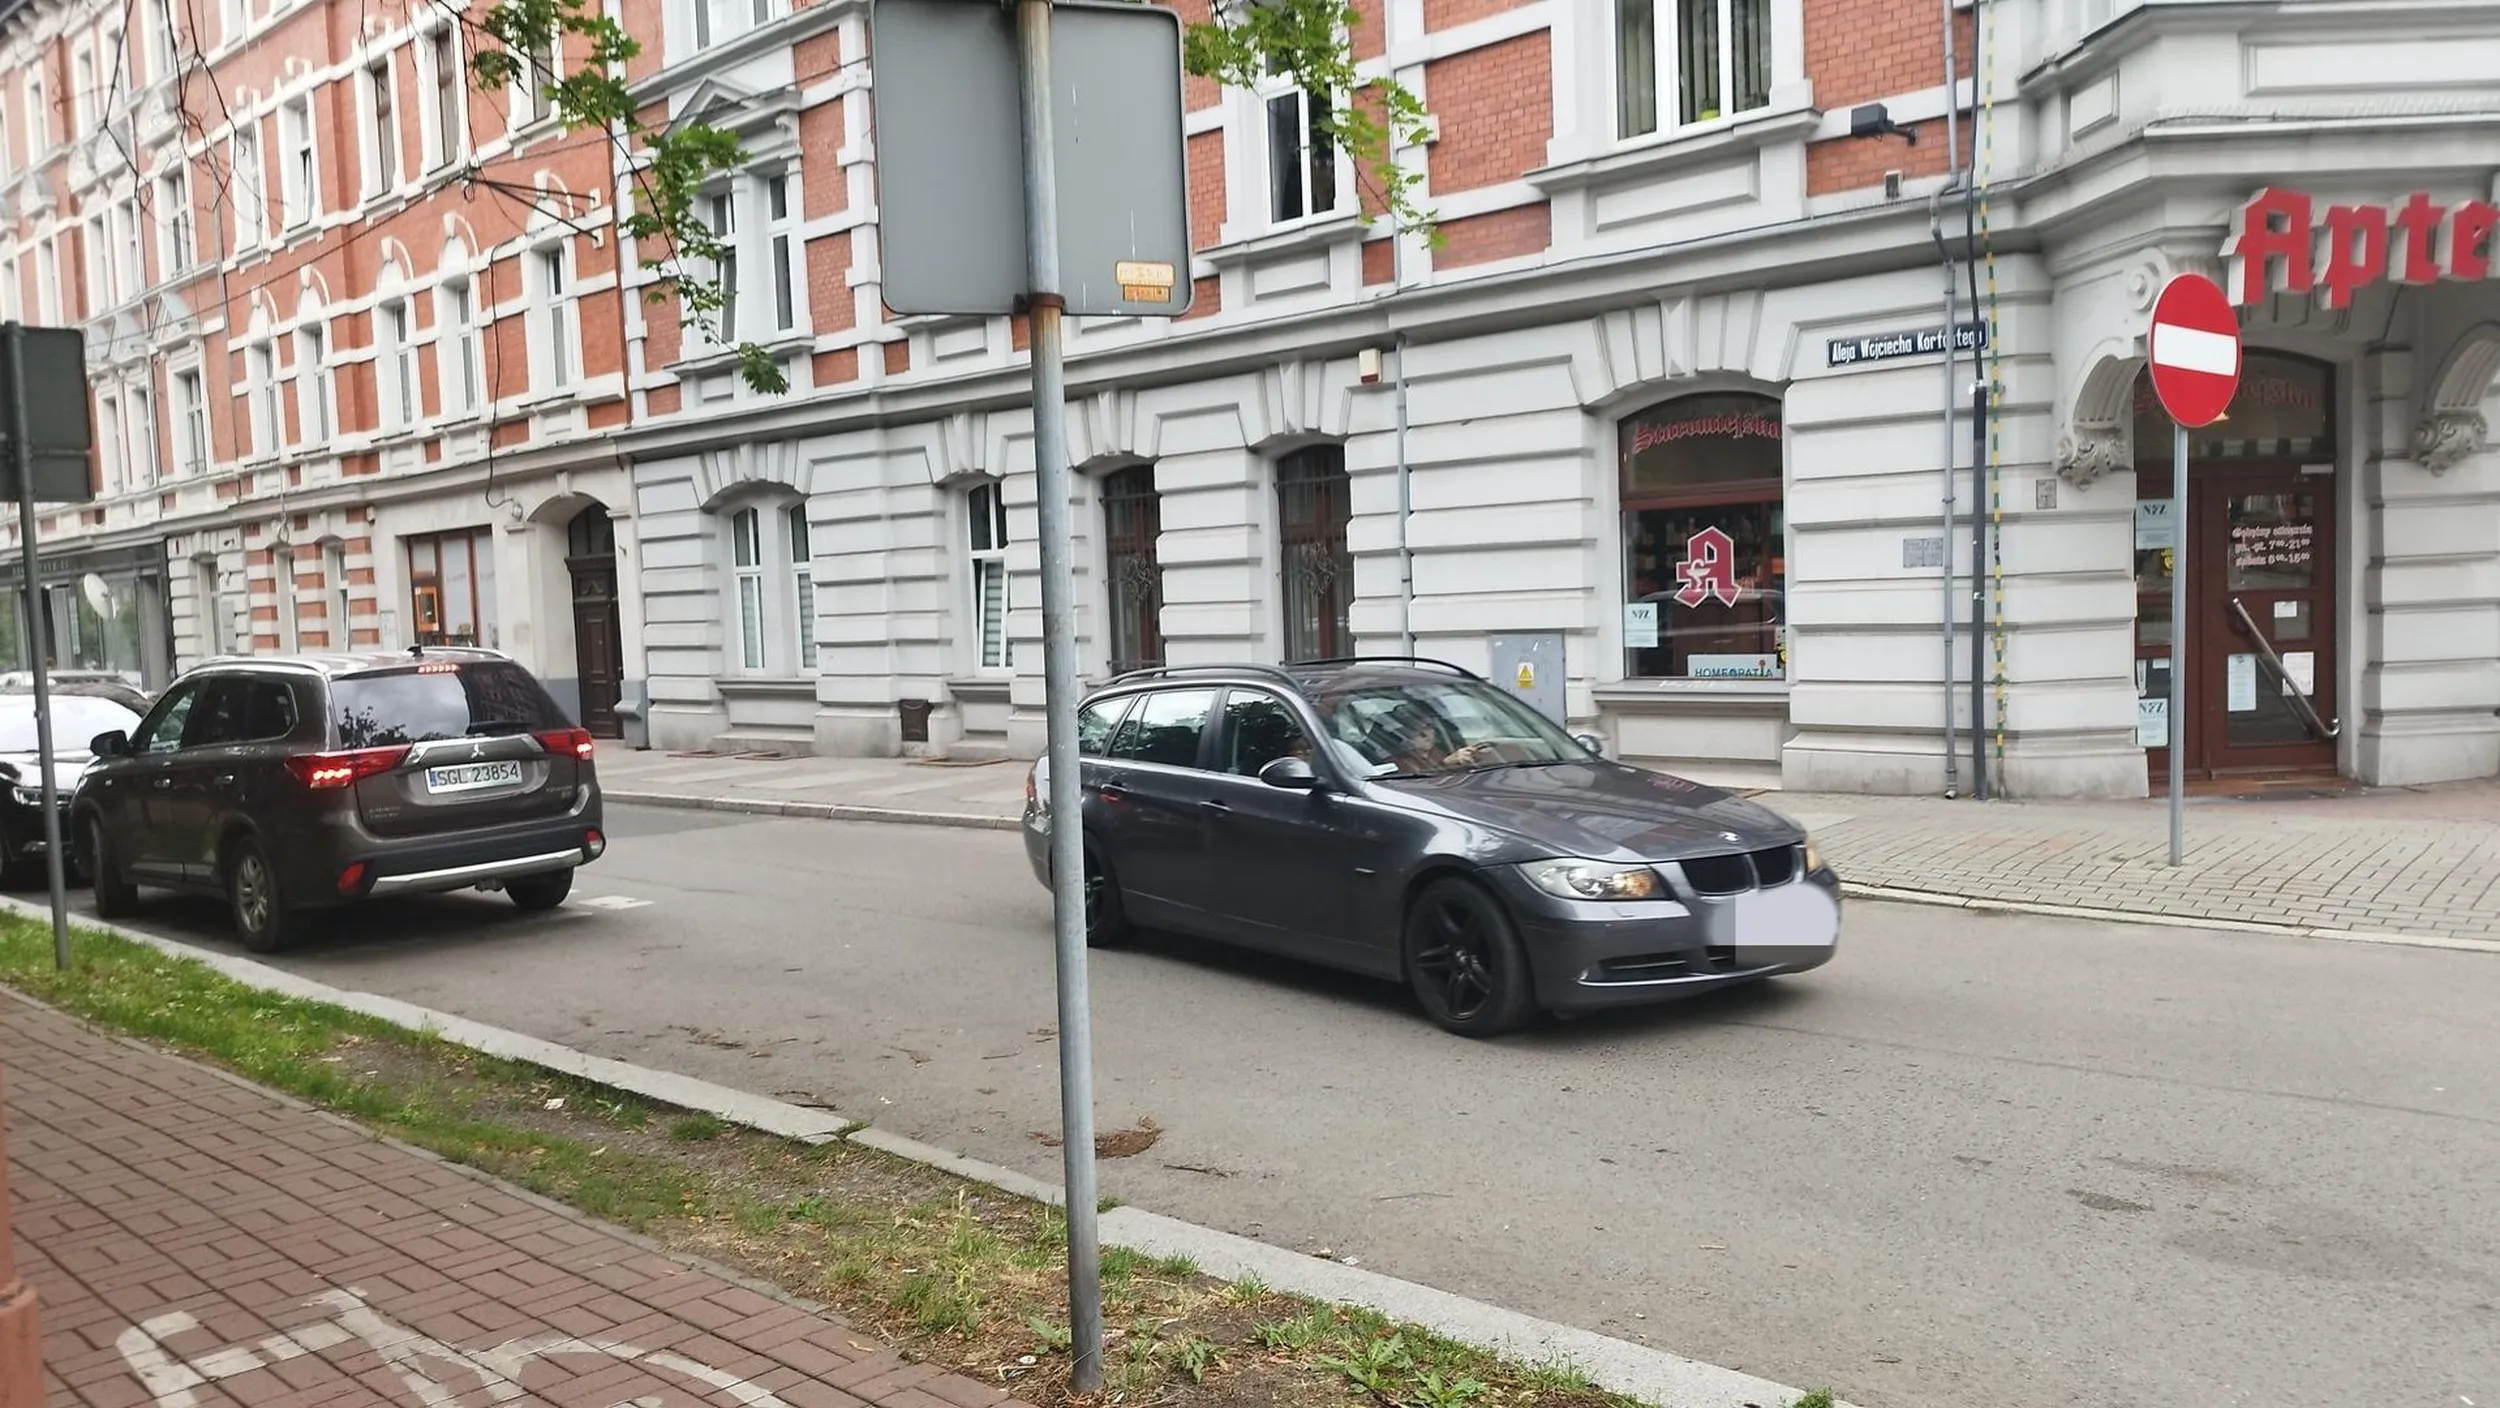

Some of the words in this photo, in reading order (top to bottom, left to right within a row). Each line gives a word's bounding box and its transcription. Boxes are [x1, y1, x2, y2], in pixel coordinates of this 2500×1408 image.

[2226, 187, 2500, 310] Apte
[1832, 341, 1856, 364] Aleja
[1860, 334, 1913, 360] Wojciecha
[437, 768, 468, 787] SGL
[472, 763, 519, 783] 23854
